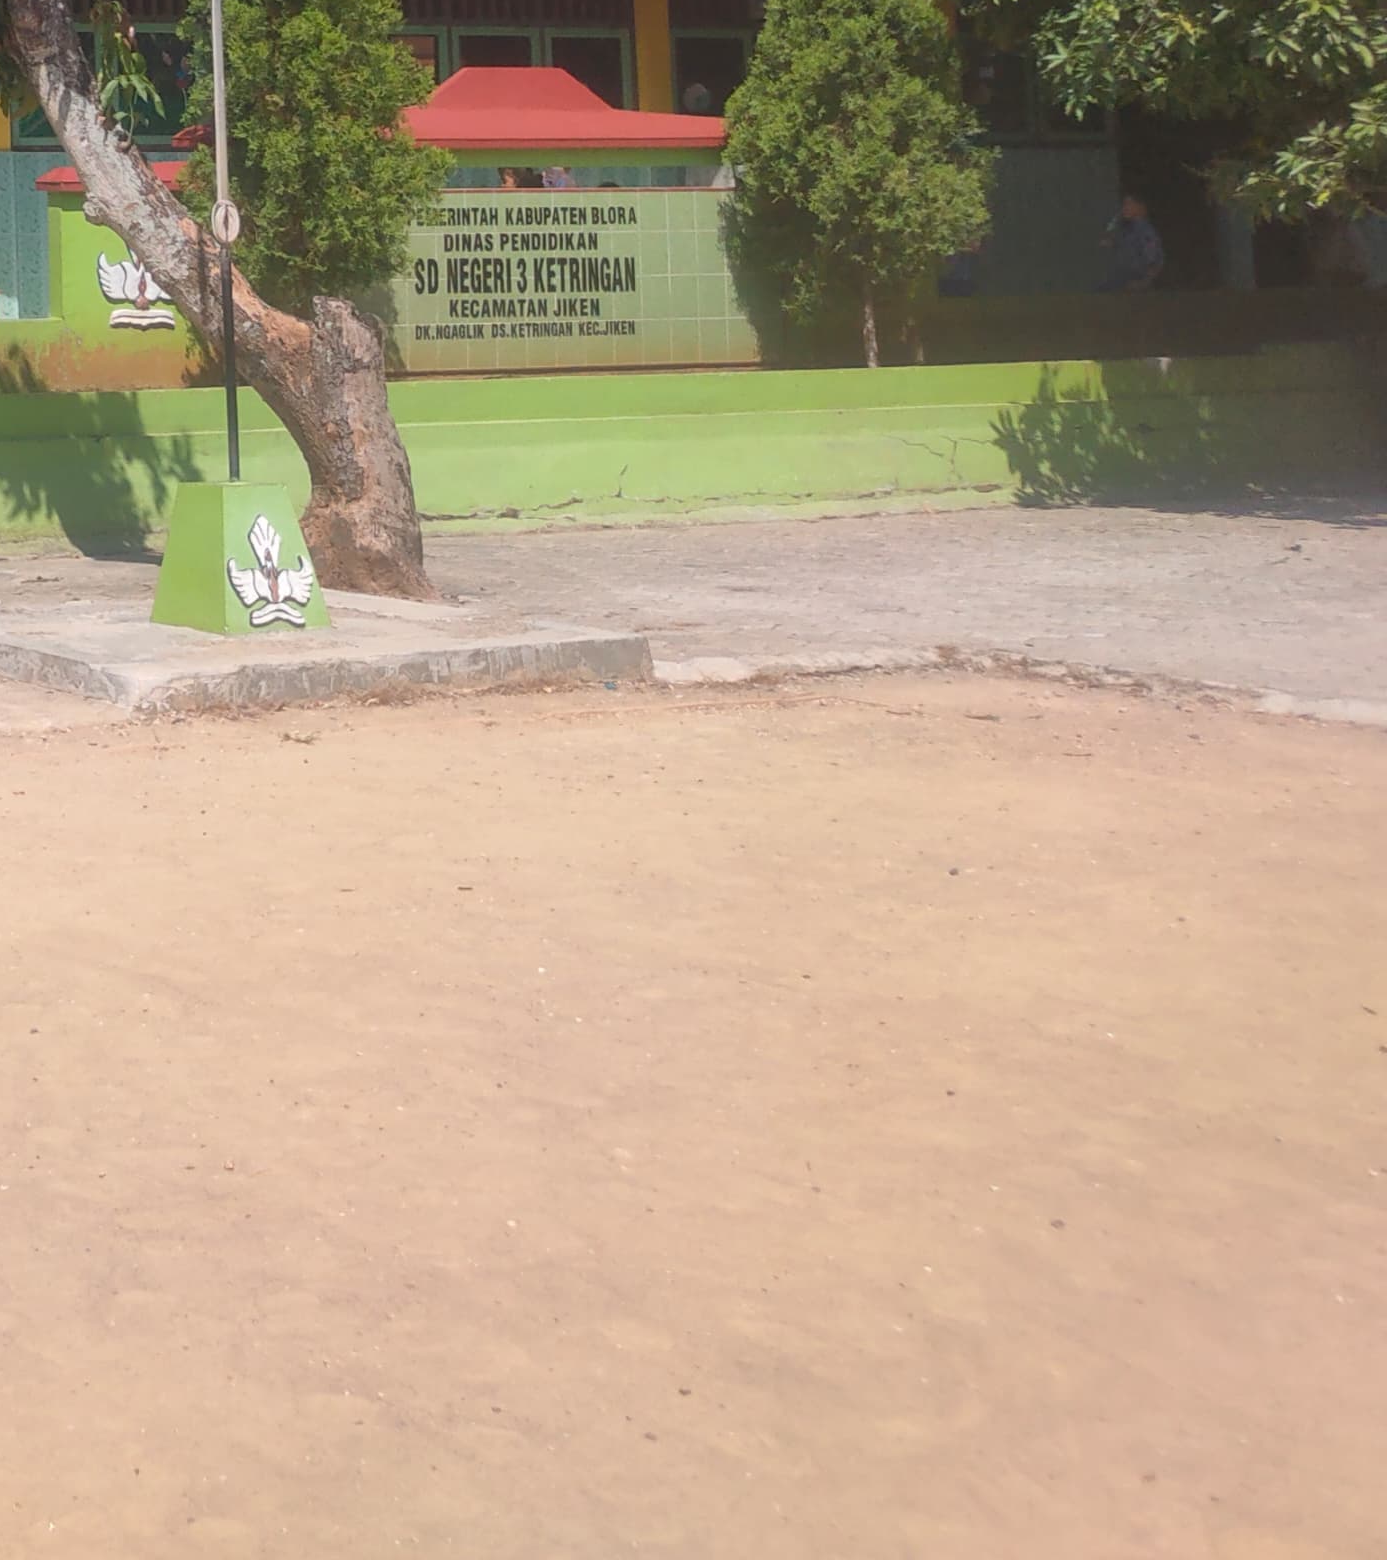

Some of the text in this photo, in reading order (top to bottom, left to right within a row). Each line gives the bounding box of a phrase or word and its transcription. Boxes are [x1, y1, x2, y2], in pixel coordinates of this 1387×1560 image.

[505, 206, 587, 226] KABUPATEN
[591, 206, 638, 225] BLORA
[443, 232, 598, 252] DINAS PENDIDIKAN
[414, 257, 636, 295] SD NEGERI 3 KETRINGAN
[449, 298, 601, 318] KECAMATAN JIKEN
[415, 324, 484, 340] DK.NGAGLIK
[491, 322, 573, 338] DS.KETRINGAN
